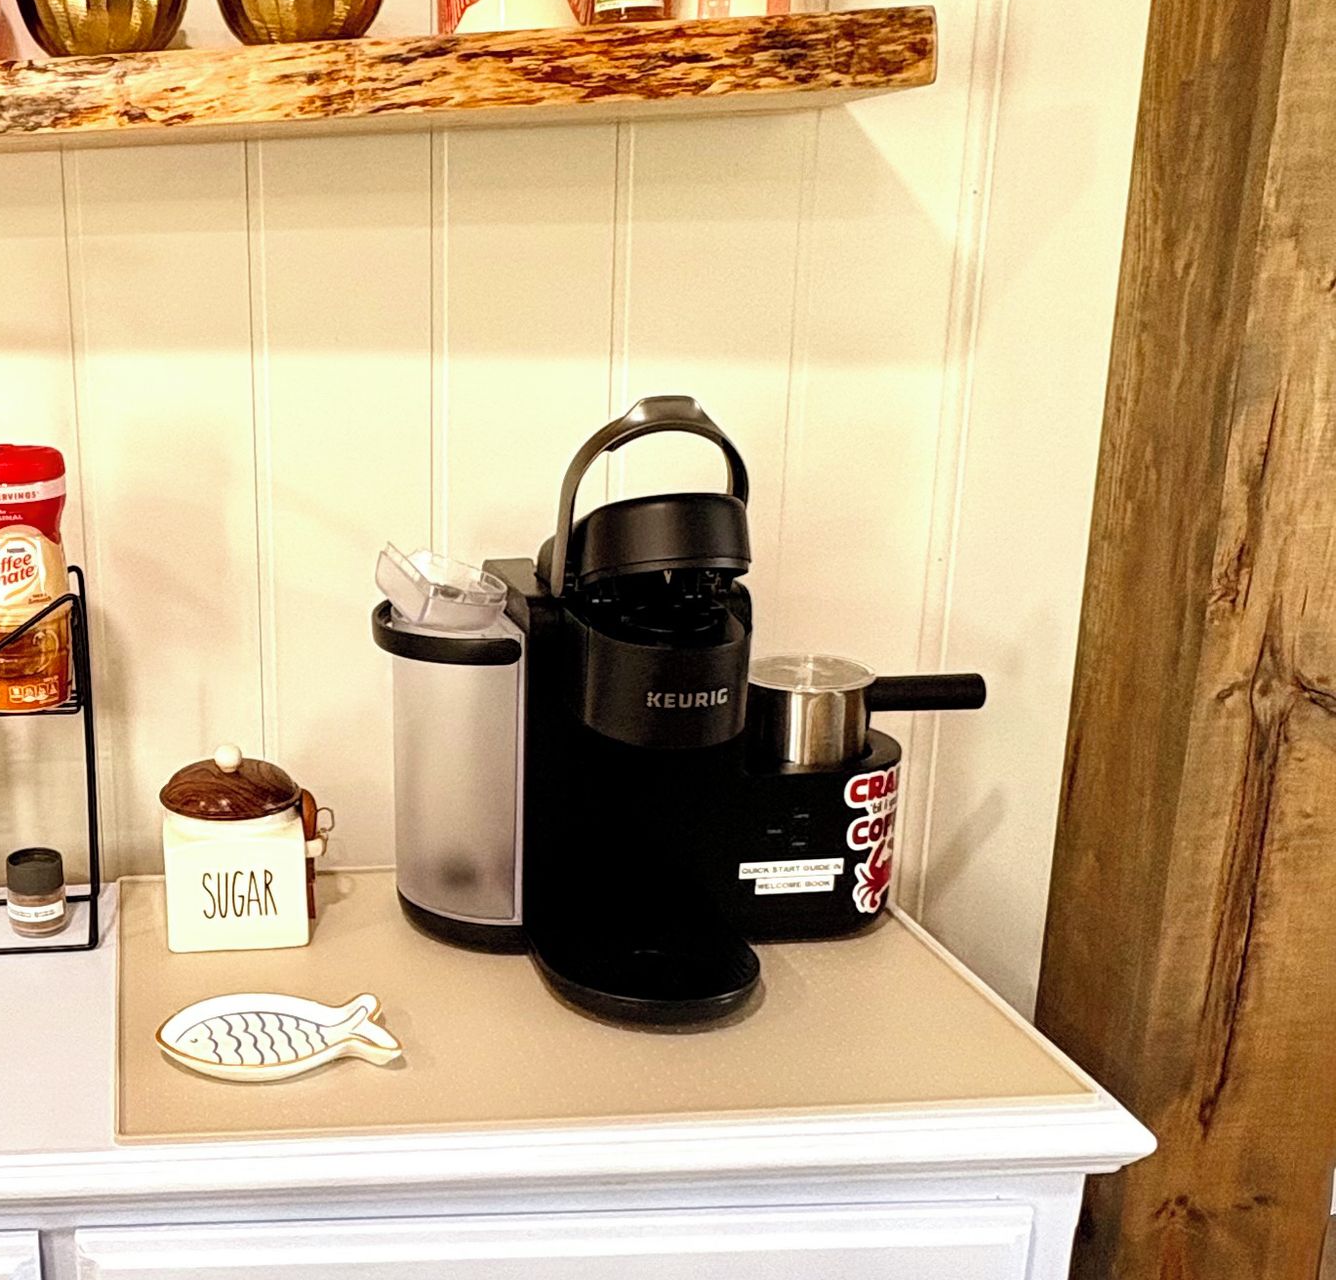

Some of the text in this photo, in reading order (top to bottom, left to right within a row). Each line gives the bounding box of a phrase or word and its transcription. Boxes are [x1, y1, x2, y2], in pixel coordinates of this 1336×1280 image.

[646, 687, 729, 709] KEURIG
[772, 865, 800, 873] START
[803, 864, 830, 872] GUIDE
[758, 880, 830, 890] WELCOME BOOK
[202, 869, 278, 919] SUGAR
